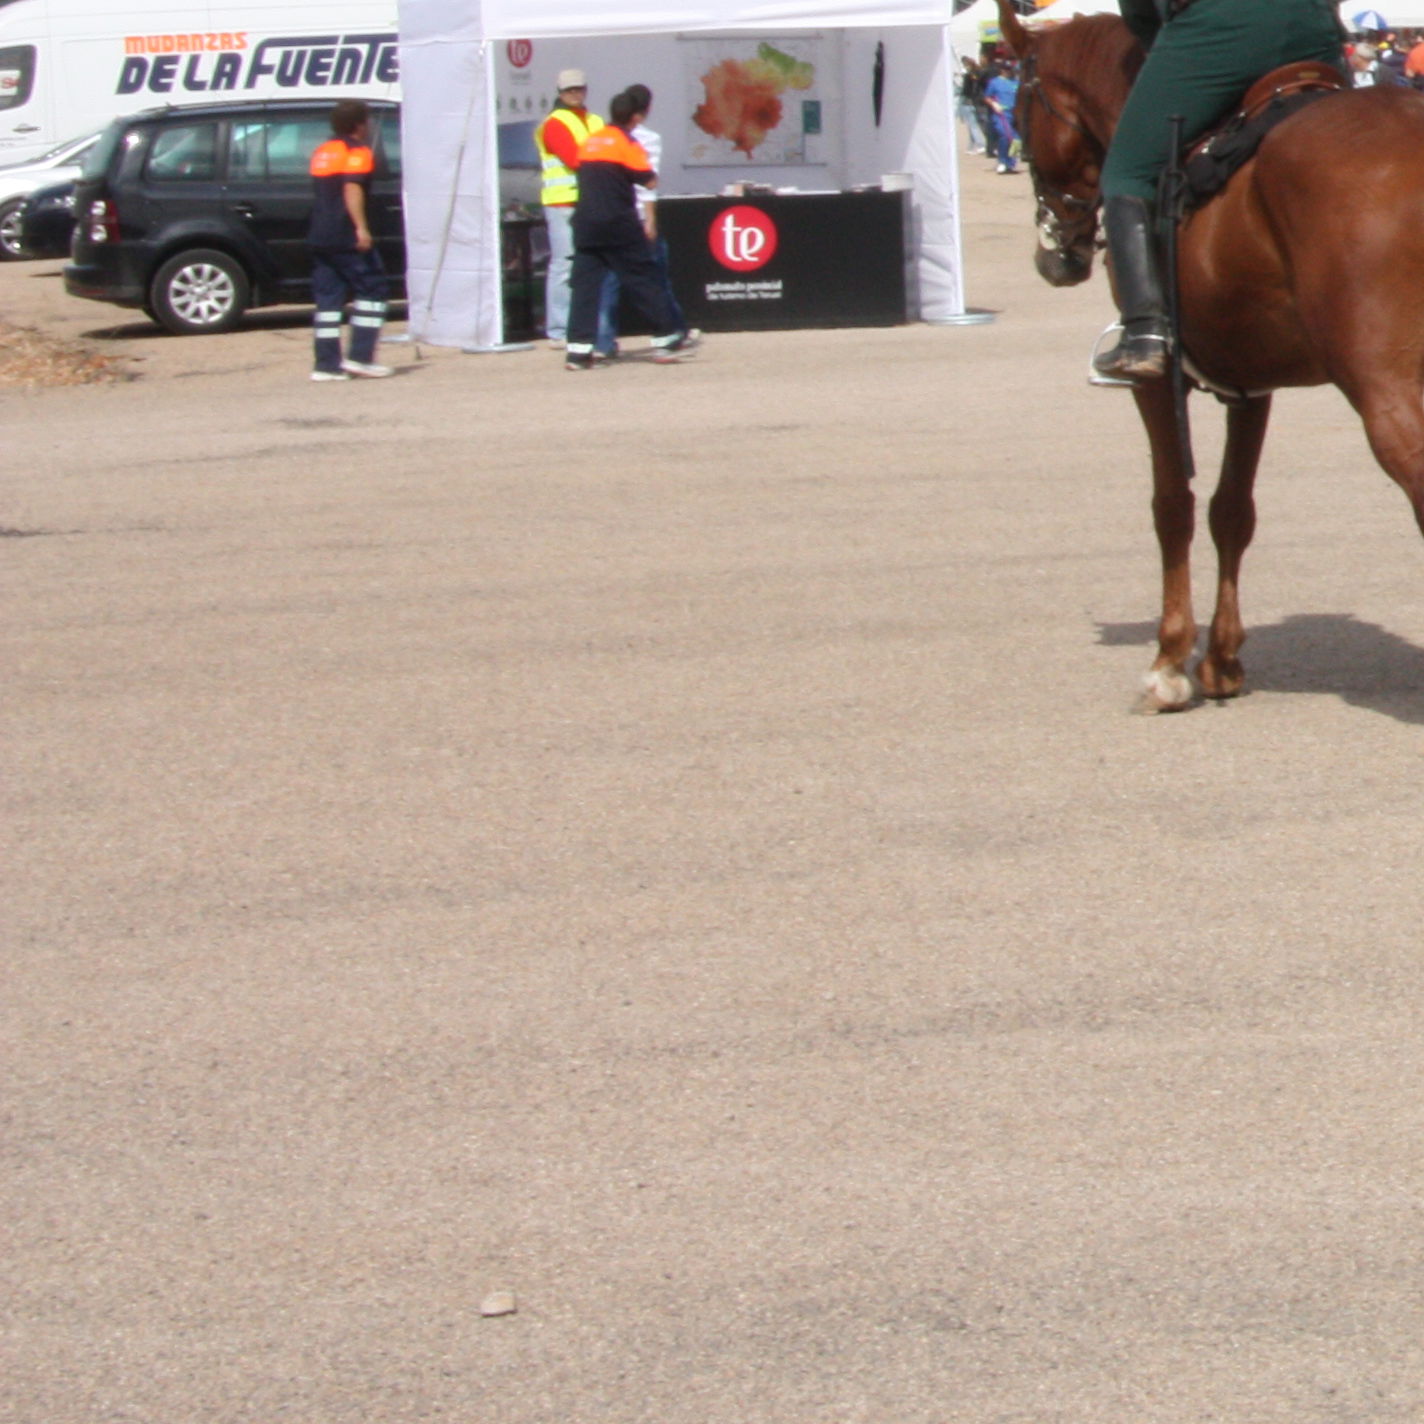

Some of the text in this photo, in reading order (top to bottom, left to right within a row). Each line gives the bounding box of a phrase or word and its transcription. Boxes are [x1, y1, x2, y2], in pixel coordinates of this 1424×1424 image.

[115, 33, 399, 95] DE LA FUENTE
[124, 32, 248, 54] MUDANZAS
[721, 214, 766, 261] te
